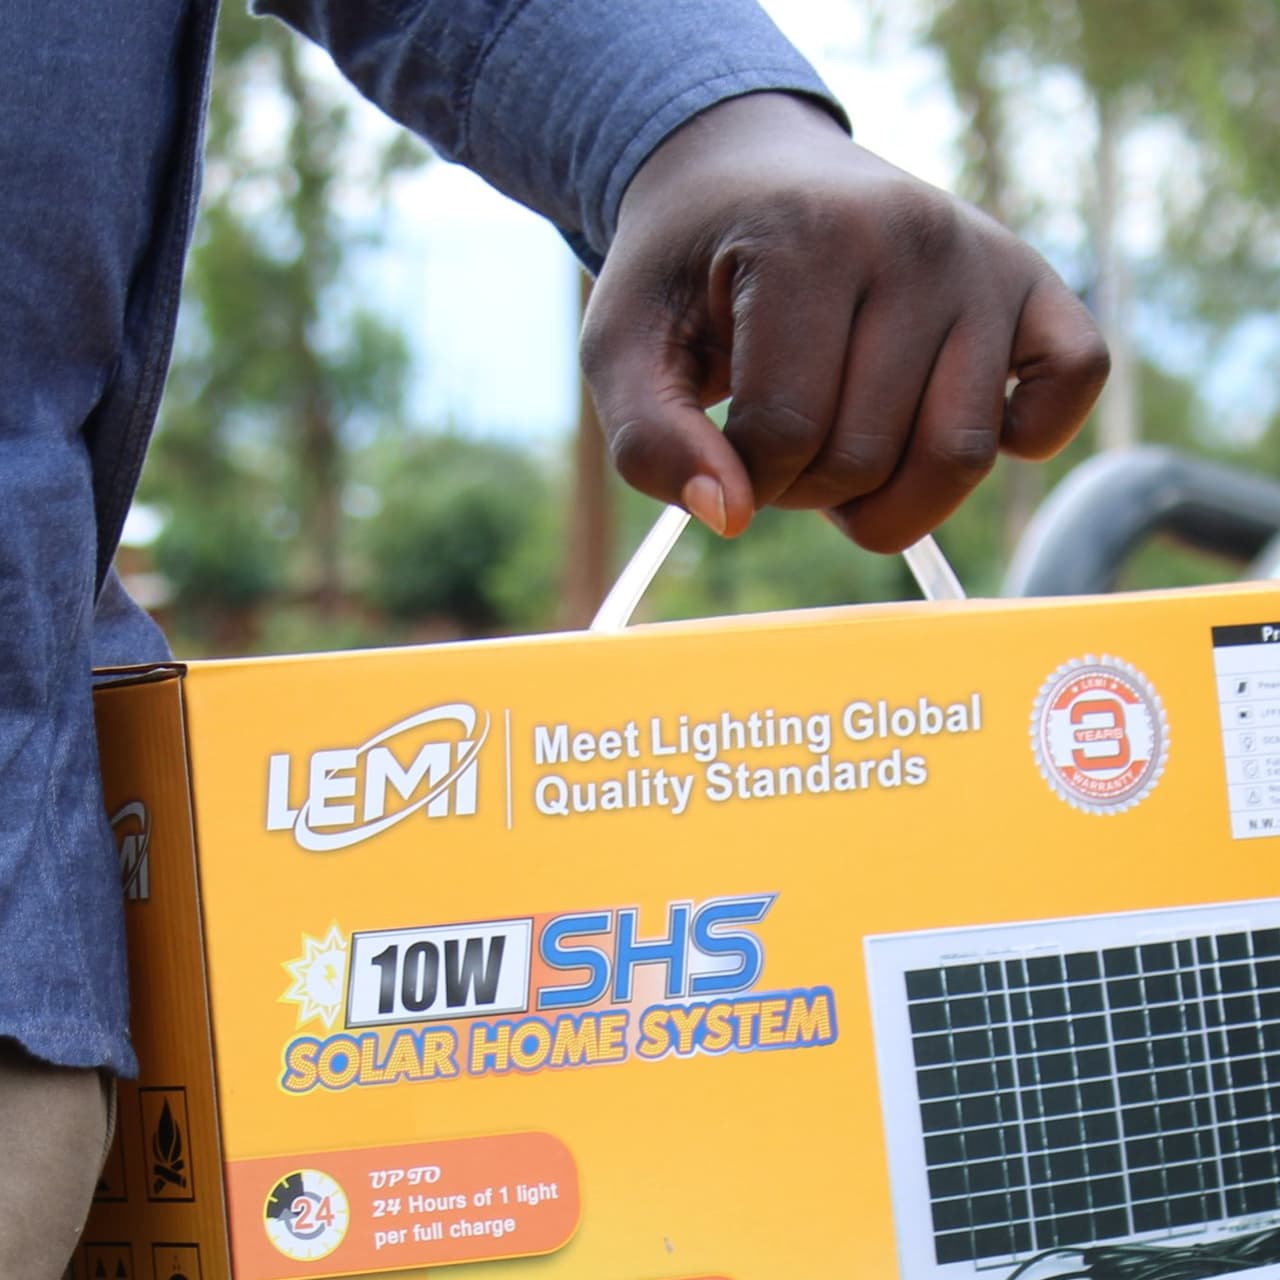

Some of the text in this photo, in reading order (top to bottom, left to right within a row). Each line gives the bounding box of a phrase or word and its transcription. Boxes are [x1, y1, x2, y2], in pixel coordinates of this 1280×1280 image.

[534, 693, 983, 764] Meet Lighting Global
[1070, 698, 1131, 772] 3
[1075, 727, 1124, 742] YEARS
[266, 709, 486, 849] LEMI
[534, 749, 928, 816] Quality Standards
[1072, 768, 1134, 792] WARRANTY
[371, 892, 782, 1016] 10W SHS
[281, 988, 838, 1094] SOLAR HOME SYSTEM
[290, 1194, 335, 1231] 24
[371, 1181, 559, 1219] 24 Hours of 1 light
[374, 1215, 516, 1250] per full charge
